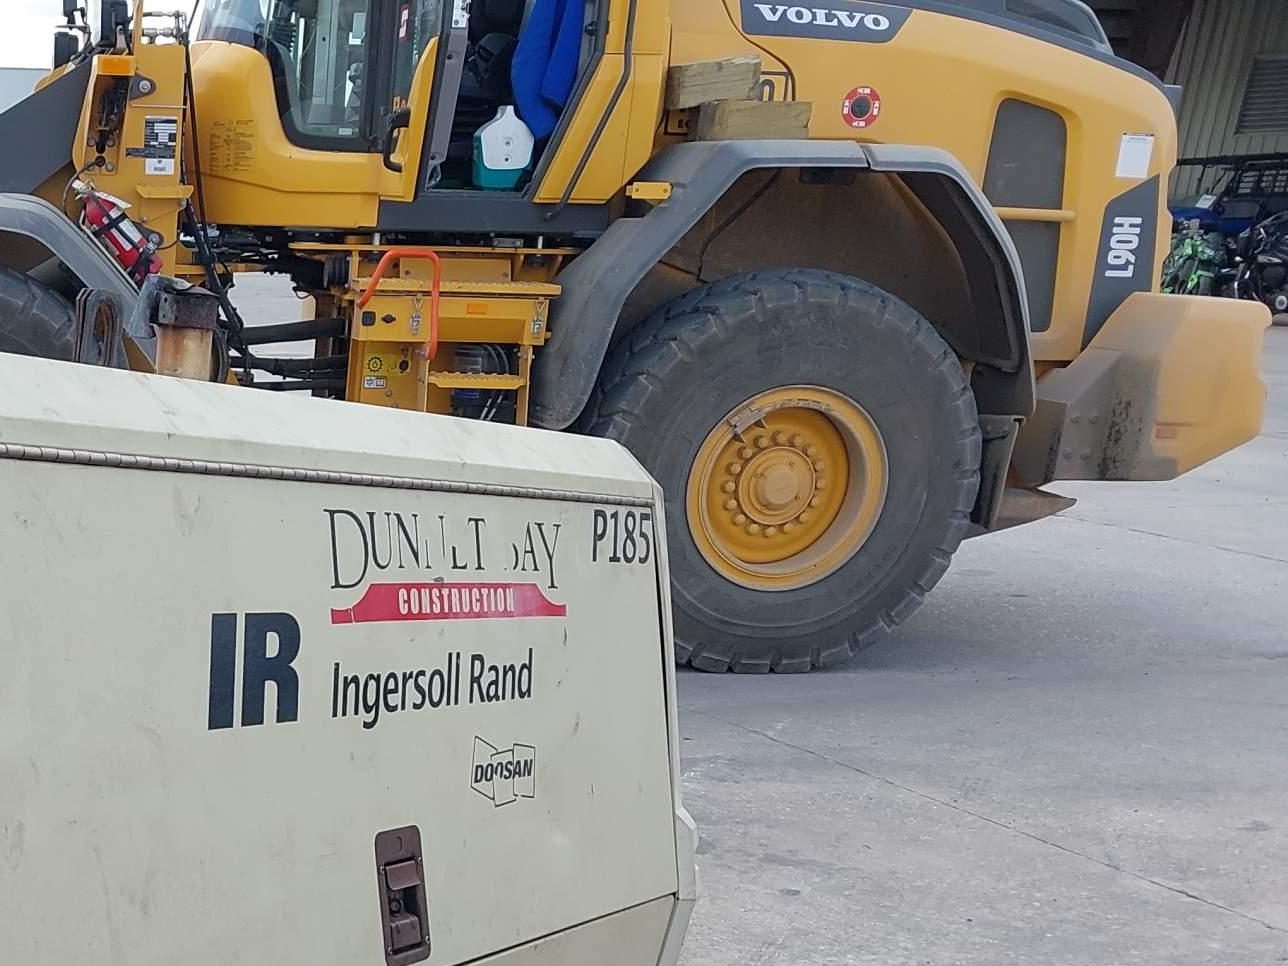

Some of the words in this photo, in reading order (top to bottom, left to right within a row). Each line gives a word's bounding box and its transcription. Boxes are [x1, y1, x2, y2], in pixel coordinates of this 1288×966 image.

[754, 4, 890, 31] VOLVO
[1104, 216, 1143, 278] L90H
[592, 509, 651, 564] P185
[398, 587, 515, 615] CONSTRUCTION
[208, 612, 301, 730] IR
[331, 652, 460, 729] Ingersoll
[469, 648, 534, 704] Rand
[474, 758, 533, 784] DOOSAN
